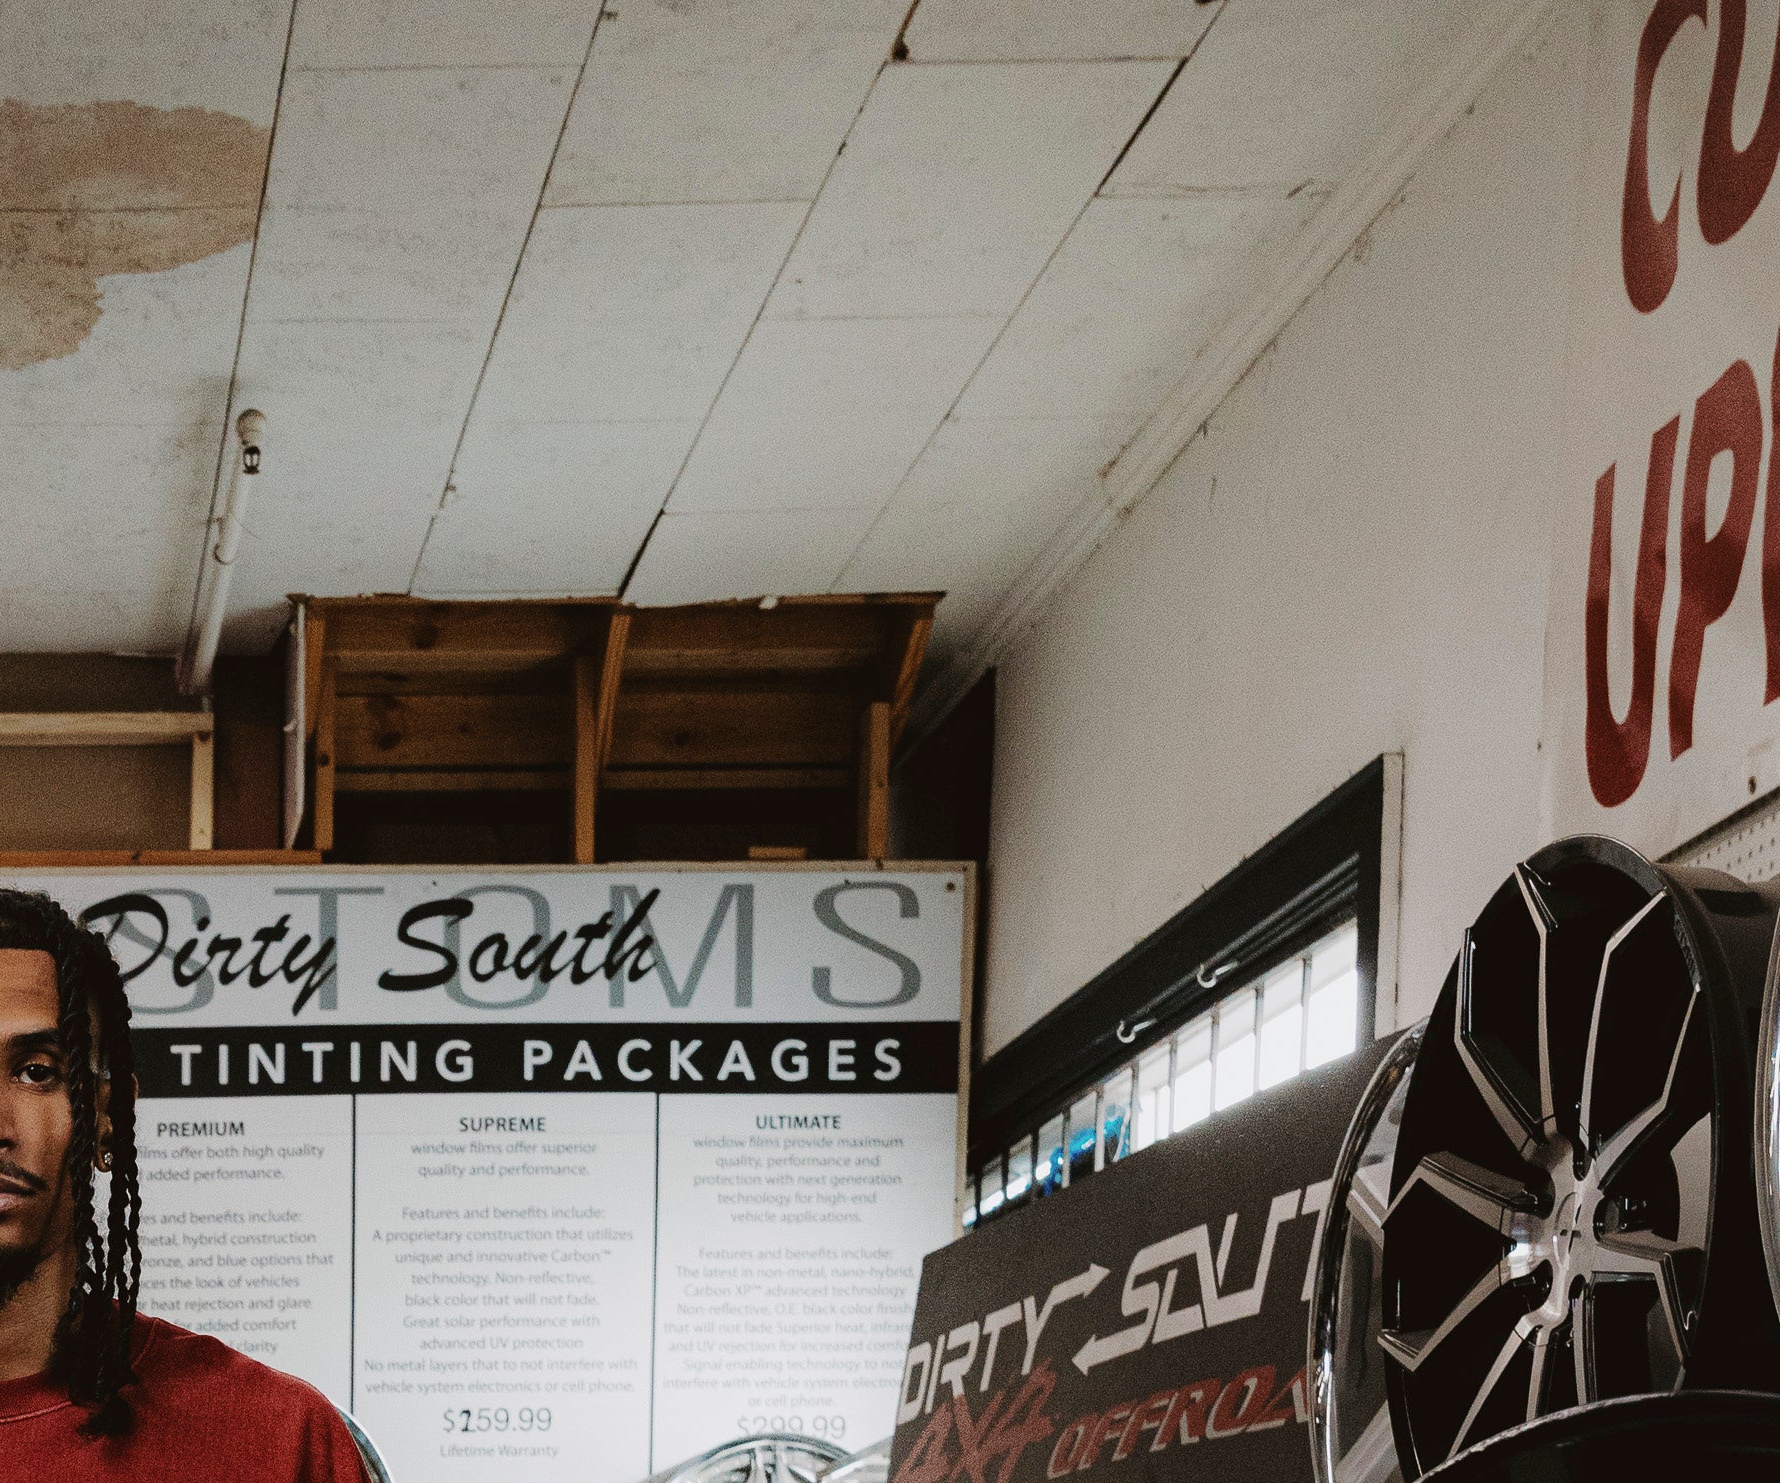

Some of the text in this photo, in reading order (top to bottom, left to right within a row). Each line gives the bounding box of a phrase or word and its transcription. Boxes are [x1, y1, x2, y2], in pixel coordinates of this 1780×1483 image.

[1622, 0, 1780, 312] CU
[84, 887, 661, 1016] Dirty South
[170, 1037, 904, 1087] TINTING PACKAGES
[156, 1121, 245, 1138] PREMIUM
[459, 1116, 545, 1133] SUPREME
[755, 1114, 841, 1130] ULTIMATE
[896, 1176, 1334, 1424] DIRTY SOUT
[443, 1407, 553, 1434] $259.99
[1047, 1365, 1312, 1481] OFFROA
[439, 1443, 559, 1459] Lifetime Warranty
